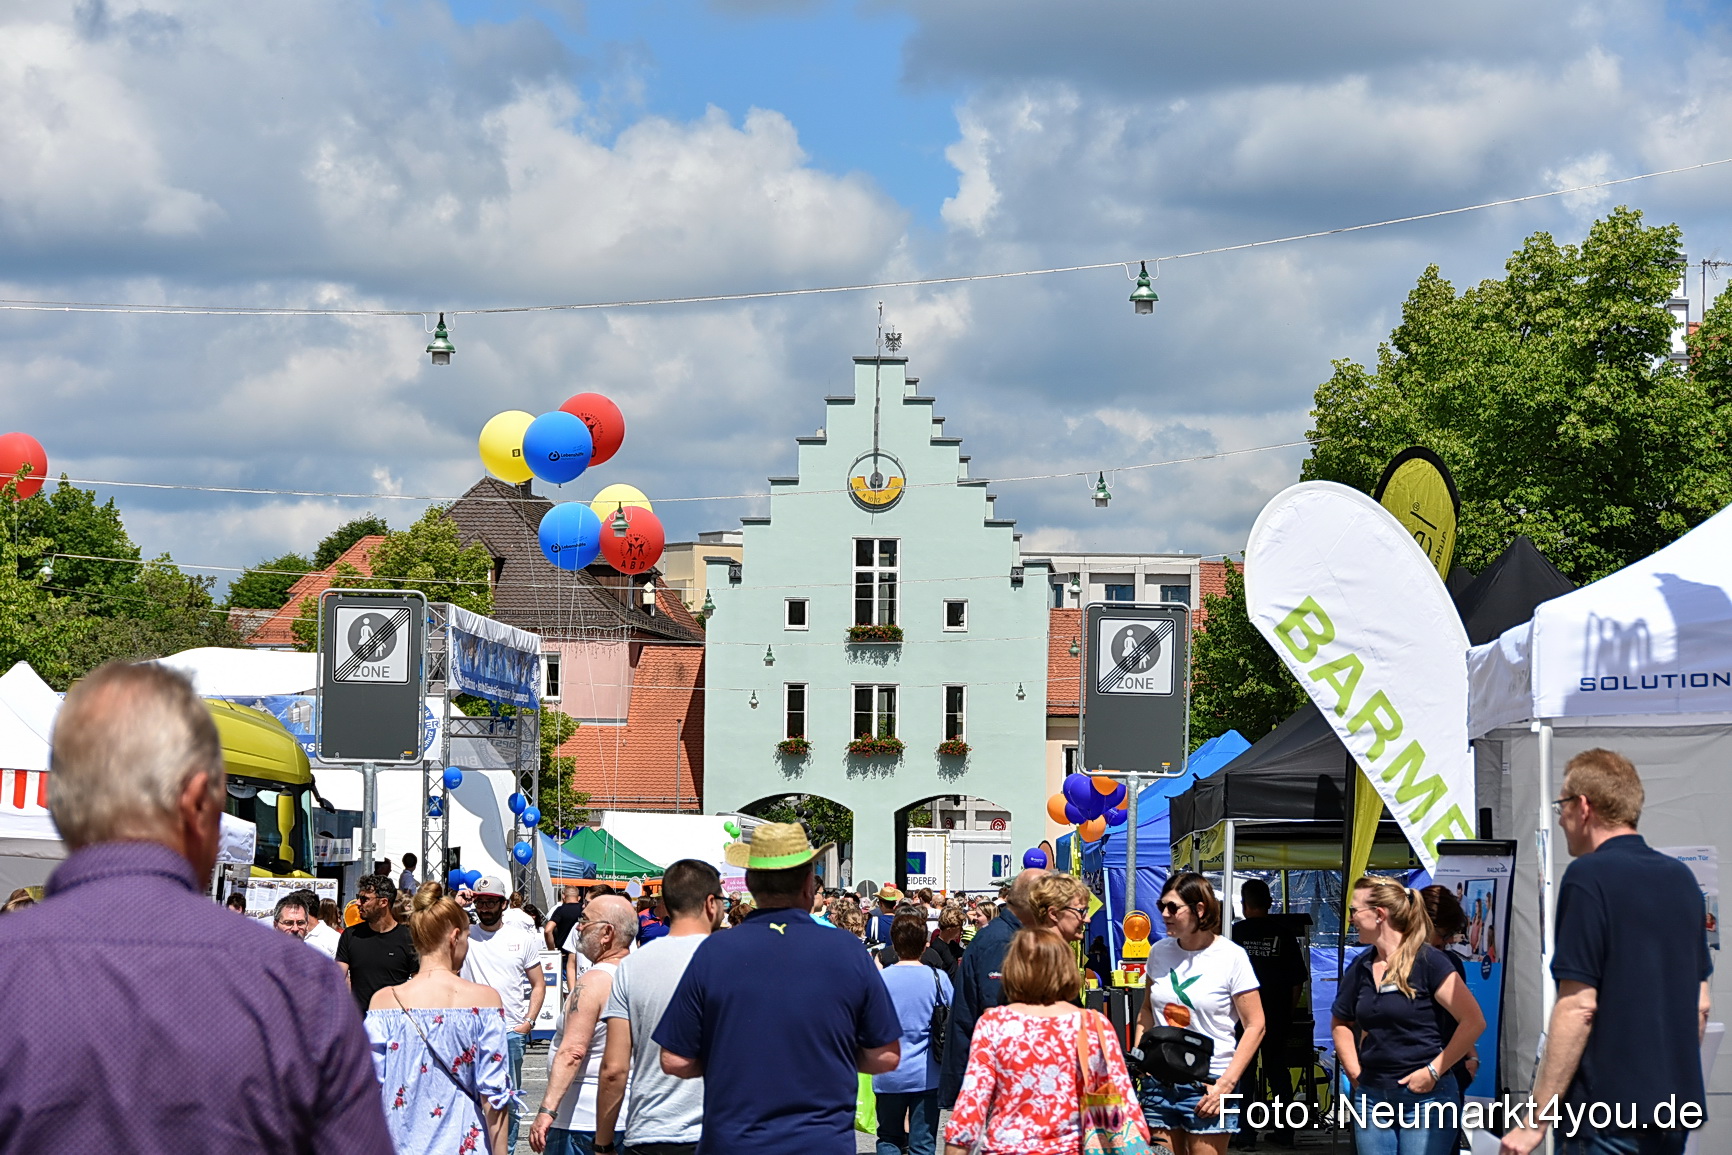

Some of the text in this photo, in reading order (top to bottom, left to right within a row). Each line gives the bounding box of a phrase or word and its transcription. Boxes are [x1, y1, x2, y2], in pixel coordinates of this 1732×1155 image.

[352, 666, 390, 678] ZONE
[1116, 677, 1154, 690] ZONE
[1579, 672, 1731, 692] SOLUTION
